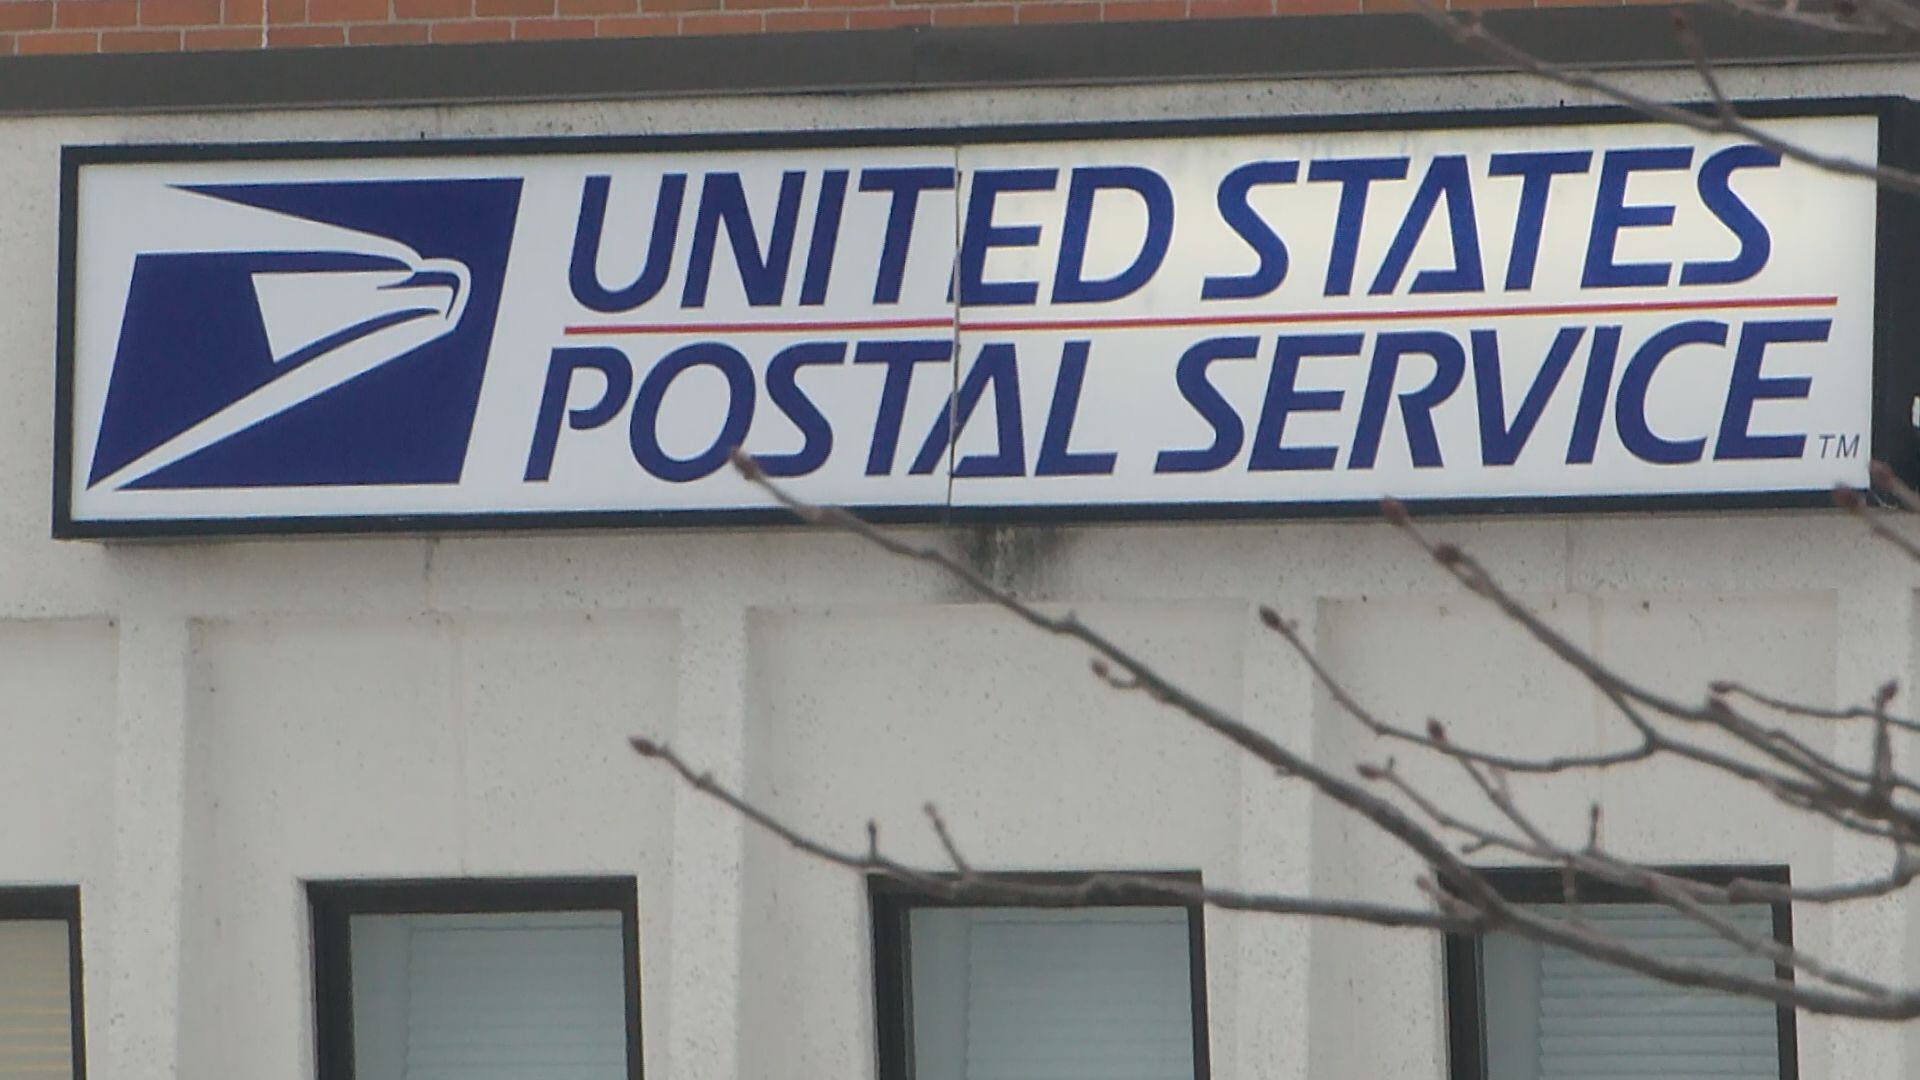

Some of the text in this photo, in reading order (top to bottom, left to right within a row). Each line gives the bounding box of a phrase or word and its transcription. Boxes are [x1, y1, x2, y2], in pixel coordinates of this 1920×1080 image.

[568, 145, 1783, 312] UNITED STATES
[524, 340, 1117, 482] POSTAL
[1154, 319, 1831, 473] SERVICE
